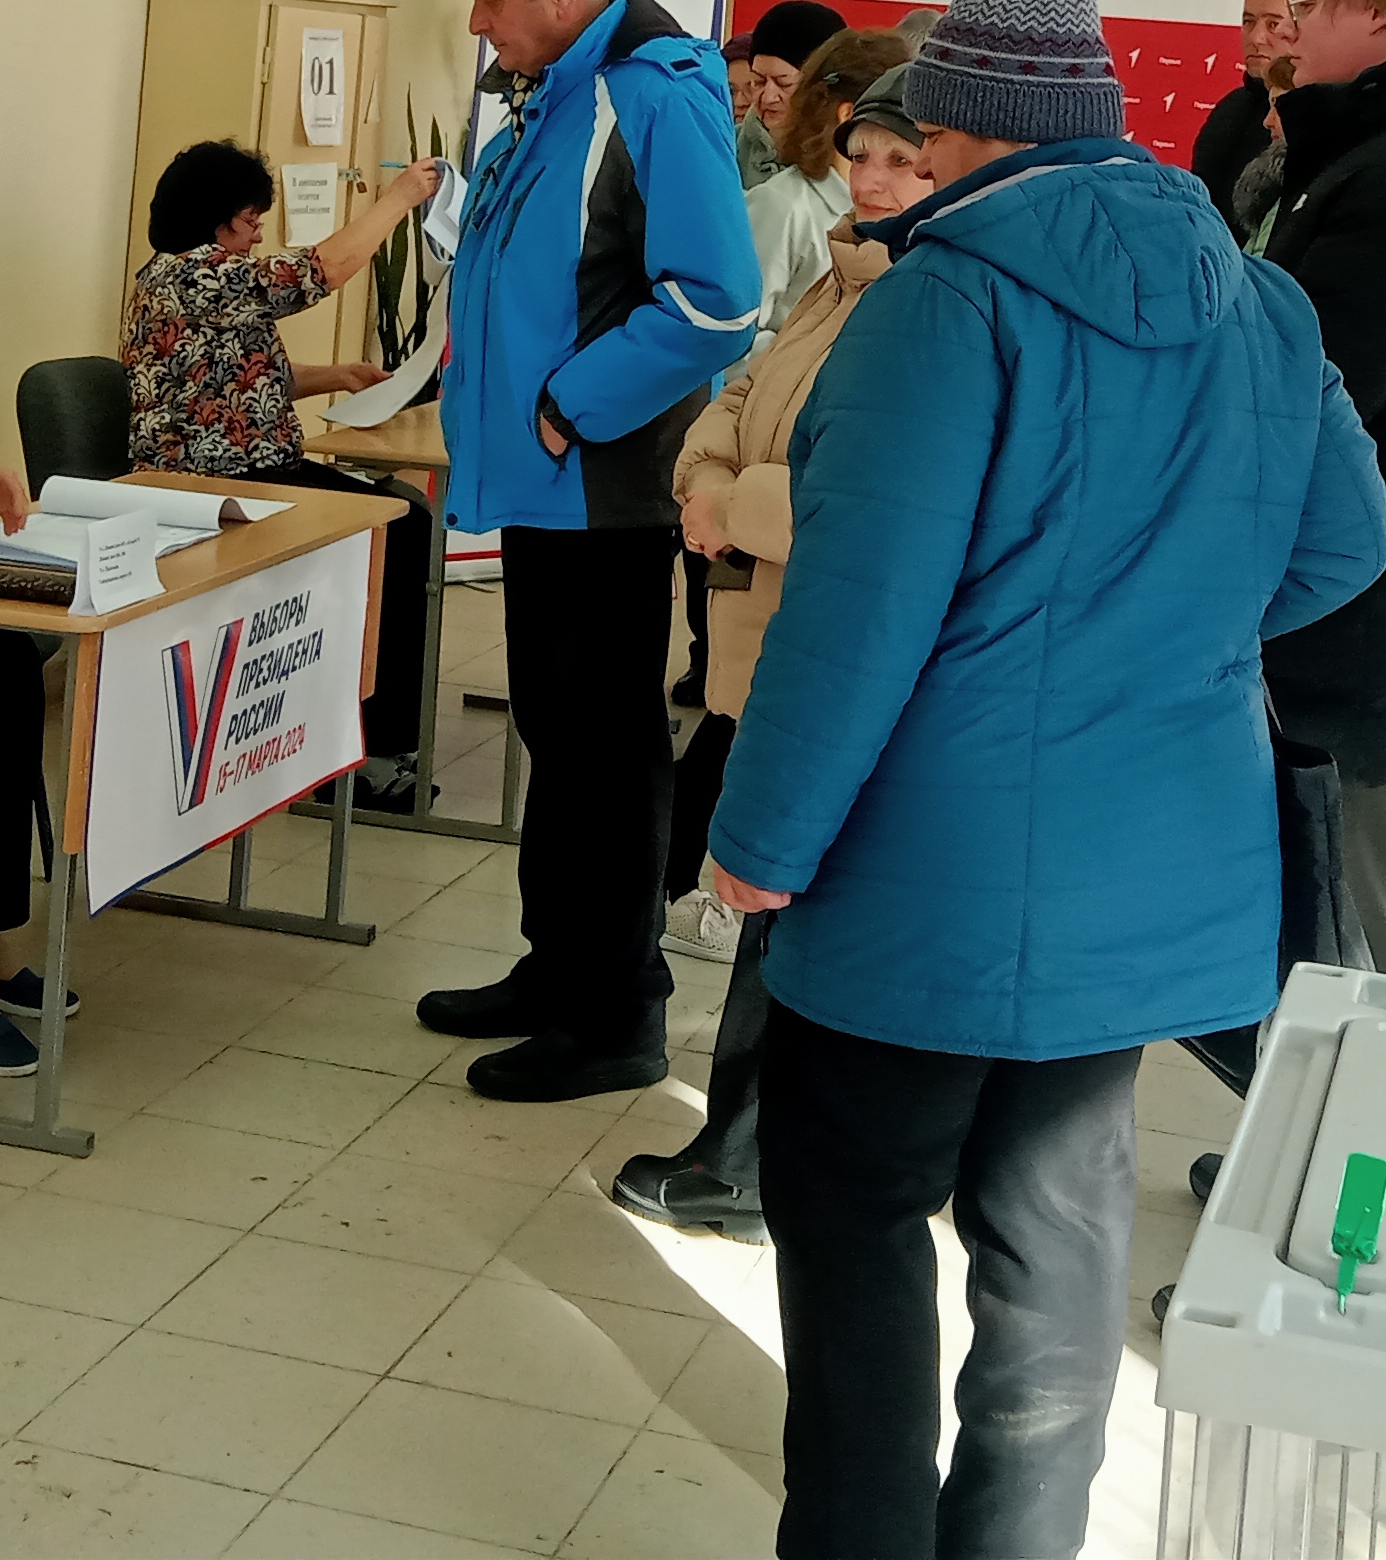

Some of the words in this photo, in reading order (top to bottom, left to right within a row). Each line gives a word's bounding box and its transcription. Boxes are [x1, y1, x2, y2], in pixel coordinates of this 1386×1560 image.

[310, 56, 338, 97] 01
[247, 590, 311, 648] ВЫБОРЫ
[235, 628, 323, 700] ПРЕЗИДЕНТА
[224, 690, 286, 751] РОССИИ
[244, 735, 282, 780] МАРТА
[280, 722, 306, 761] 2024
